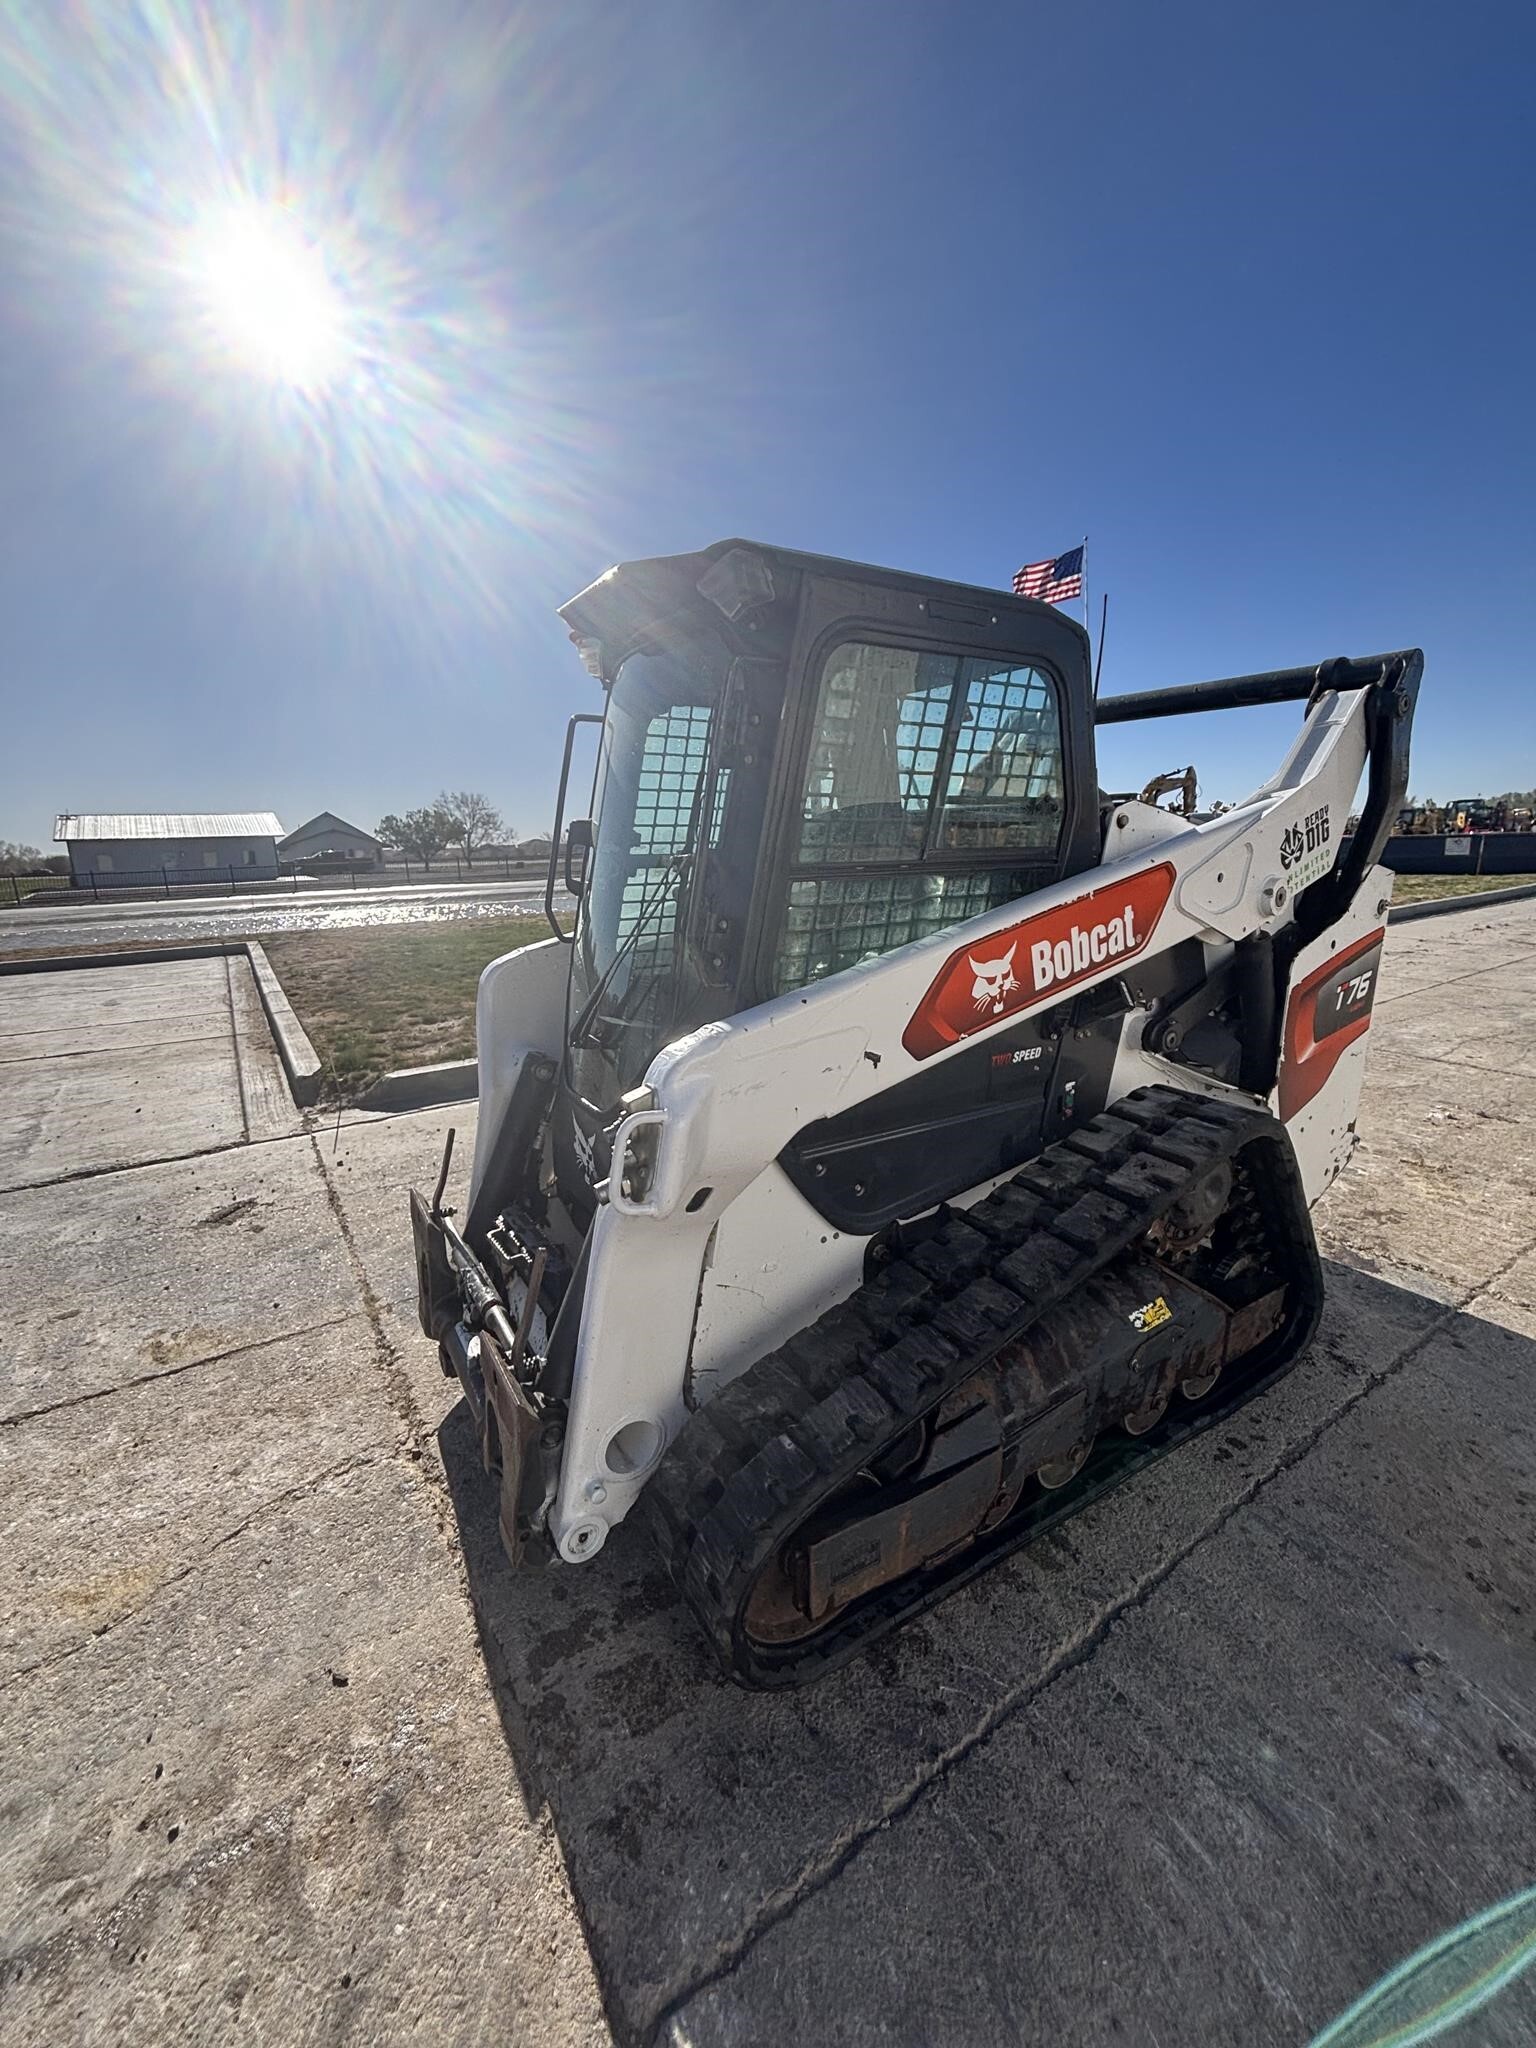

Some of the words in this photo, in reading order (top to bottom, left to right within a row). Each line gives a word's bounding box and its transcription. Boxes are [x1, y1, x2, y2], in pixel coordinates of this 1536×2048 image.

[1304, 804, 1329, 829] READY
[1305, 818, 1330, 853] DIG
[1287, 849, 1331, 880] NLIMITED
[1031, 905, 1136, 991] Bobcat
[1335, 970, 1373, 1011] T76
[991, 1052, 1012, 1066] TWO
[1012, 1046, 1043, 1063] SPEED
